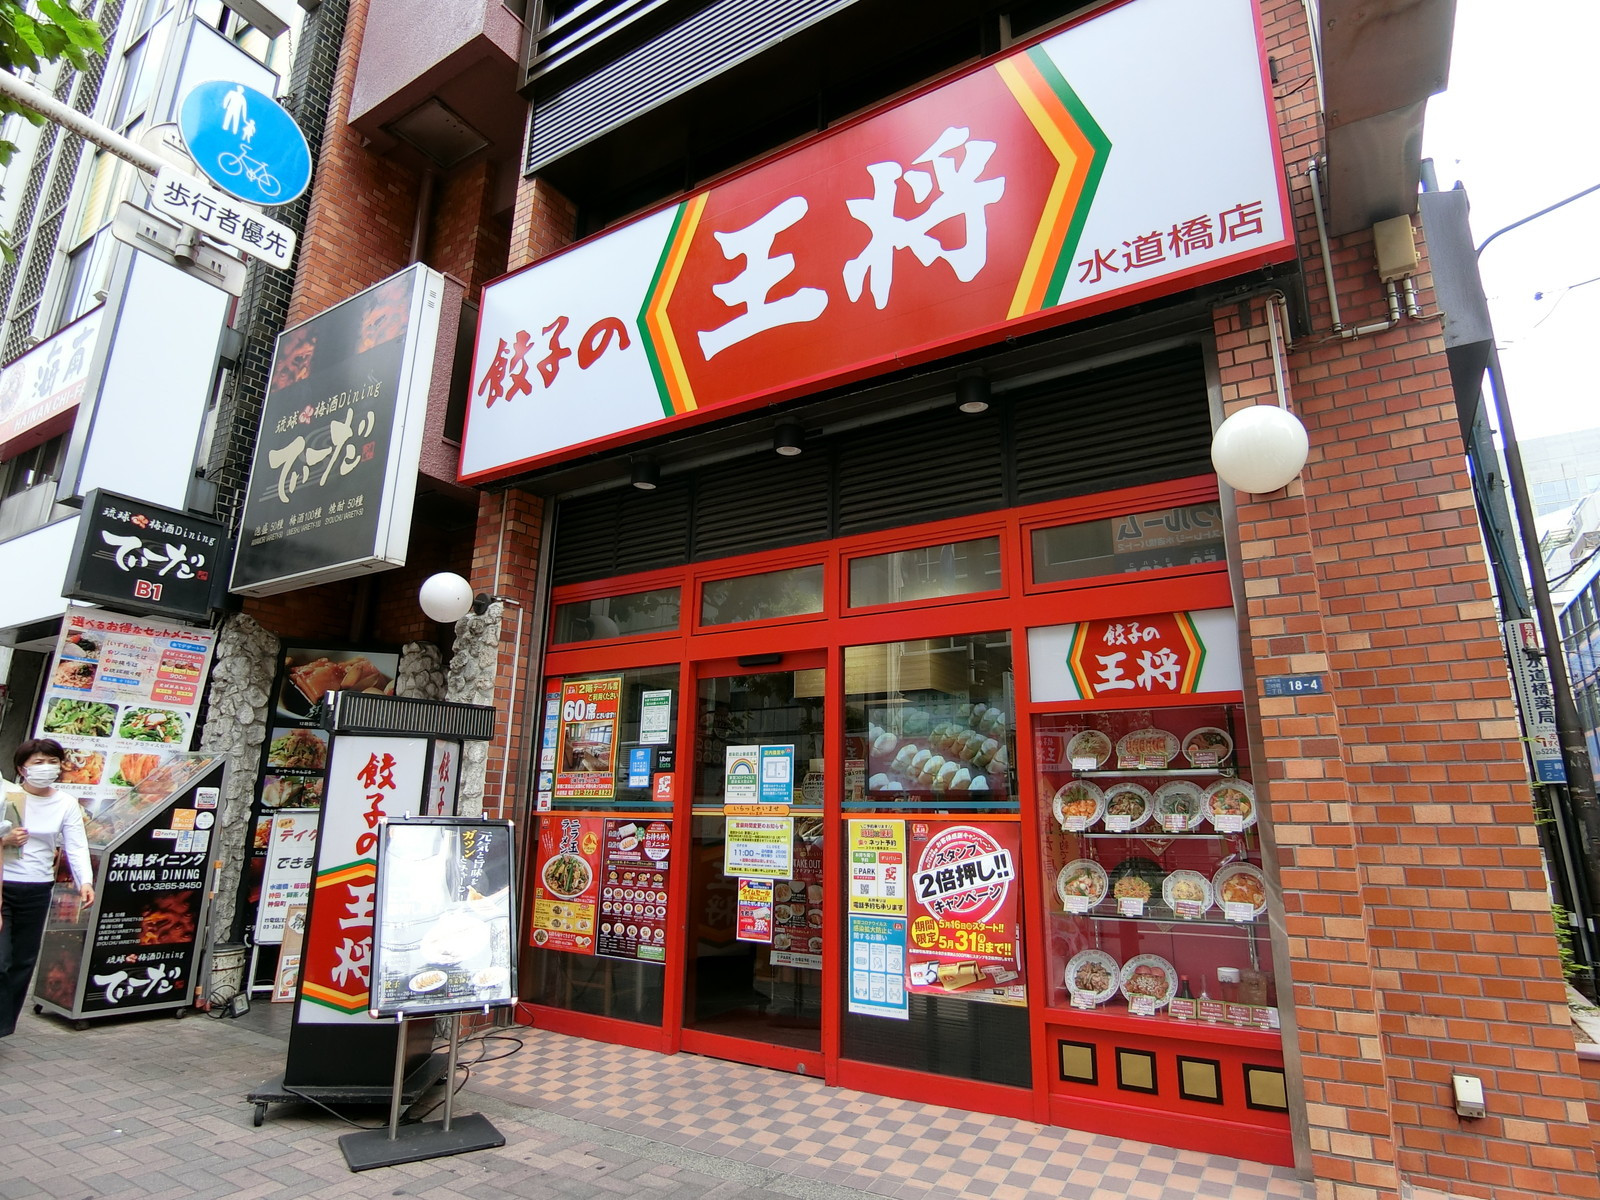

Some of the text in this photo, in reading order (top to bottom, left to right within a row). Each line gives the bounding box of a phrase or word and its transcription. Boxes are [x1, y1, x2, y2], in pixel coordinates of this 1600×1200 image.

[163, 180, 291, 260] 歩行者優先
[1078, 199, 1265, 286] 水道橋店
[478, 126, 1007, 409] 餃子の 王将
[274, 410, 299, 434] 琉球
[102, 506, 132, 523] 琉球
[134, 579, 163, 601] B1
[70, 615, 212, 642] 選べるお得なセットメニュー
[1102, 622, 1160, 646] 餃子の
[1093, 647, 1181, 693] 王将
[1288, 679, 1318, 691] 18-4
[563, 699, 597, 722] 60席
[355, 752, 397, 856] 餃子の
[560, 819, 571, 854] ラーメン
[569, 819, 581, 854] ニラ玉
[645, 833, 670, 841] お持ち帰り
[868, 839, 897, 847] ネット予約
[111, 853, 206, 868] 沖縄ダイニング
[734, 849, 755, 857] 11:00
[809, 858, 821, 869] OUT
[936, 842, 978, 865] スタンプ
[109, 868, 200, 882] OKINAWA DINING
[138, 881, 202, 891] 03-3265-9450
[920, 853, 1009, 899] 2倍押し!!
[853, 901, 904, 911] 電話予約も承ります
[935, 886, 1001, 913] キャンペーン
[853, 926, 893, 934] 感染拡大防止に
[853, 932, 888, 941] 関するお願い
[914, 920, 936, 932] 期間
[916, 933, 937, 945] 限定
